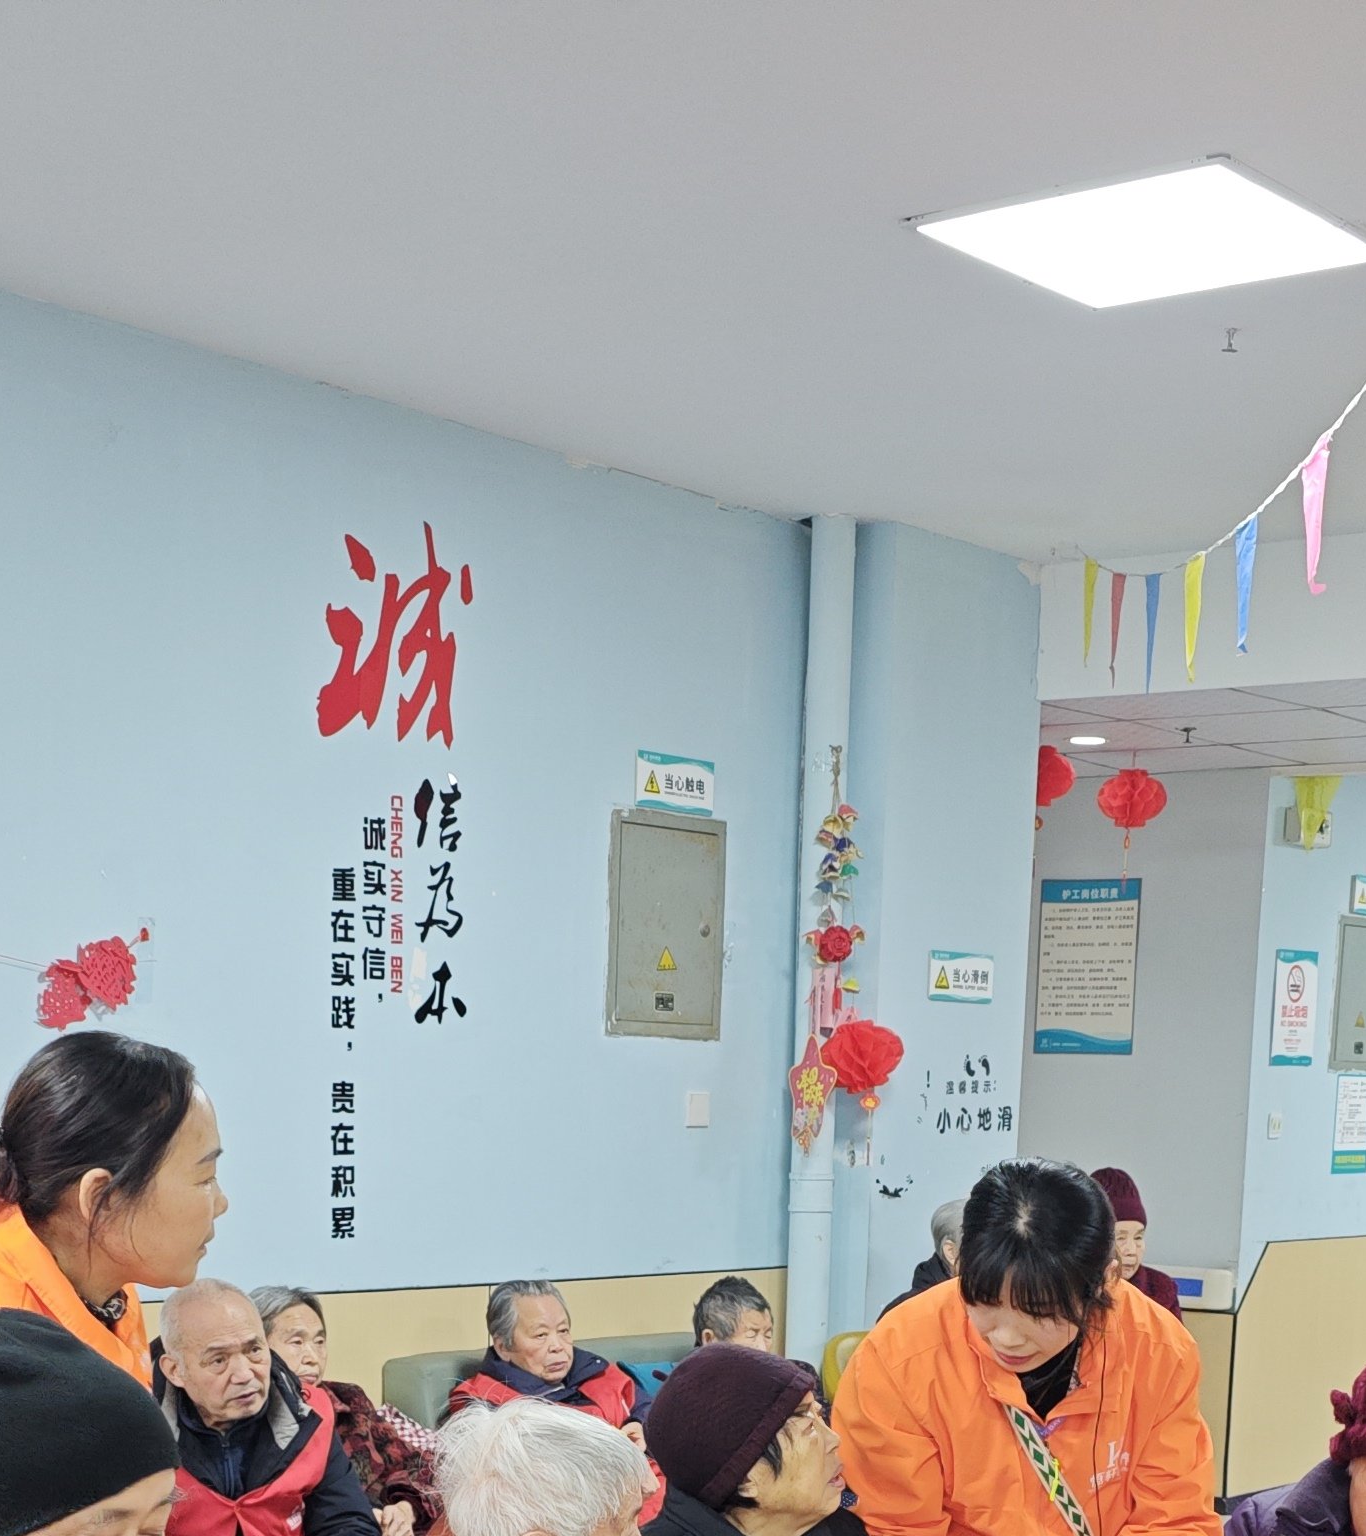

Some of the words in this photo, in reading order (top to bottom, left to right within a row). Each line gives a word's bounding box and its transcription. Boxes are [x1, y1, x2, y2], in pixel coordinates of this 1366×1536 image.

[664, 773, 705, 795] 当心触电
[390, 795, 403, 858] CHENG
[390, 869, 403, 903] XIN
[361, 815, 388, 1003] 诚实守信，
[390, 914, 403, 944] WEI
[390, 956, 403, 993] BEN
[952, 967, 989, 985] 当心滑倒
[330, 866, 356, 1240] 重在实践，贵在积累
[936, 1105, 1013, 1134] 小心地滑
